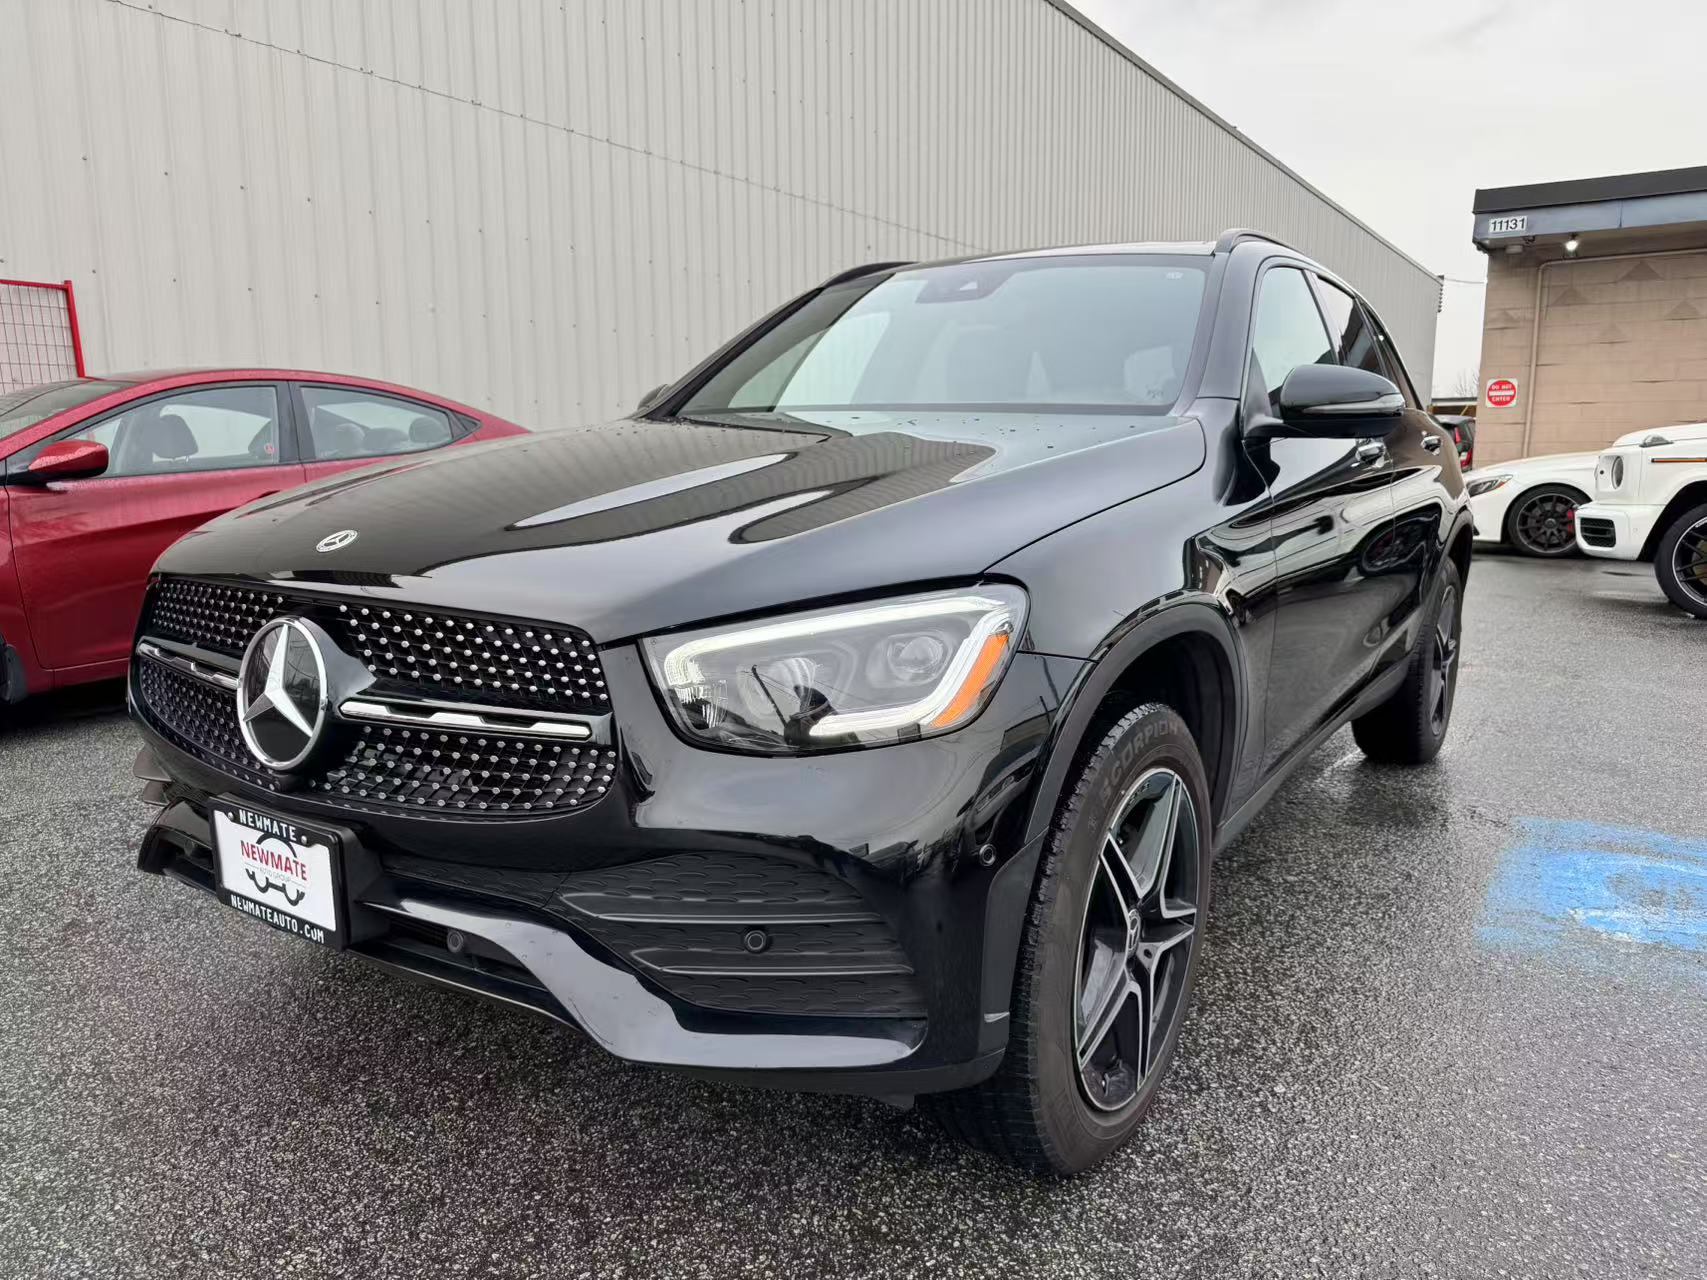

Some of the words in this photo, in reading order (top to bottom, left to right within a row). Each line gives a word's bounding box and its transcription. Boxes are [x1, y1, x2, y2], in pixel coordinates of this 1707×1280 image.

[1491, 217, 1525, 231] 11131
[1102, 718, 1181, 800] SCORPION
[239, 809, 297, 841] NEWMATE
[240, 840, 307, 881] NEWMATE
[230, 894, 325, 944] NEWMATEAUTO.COM
